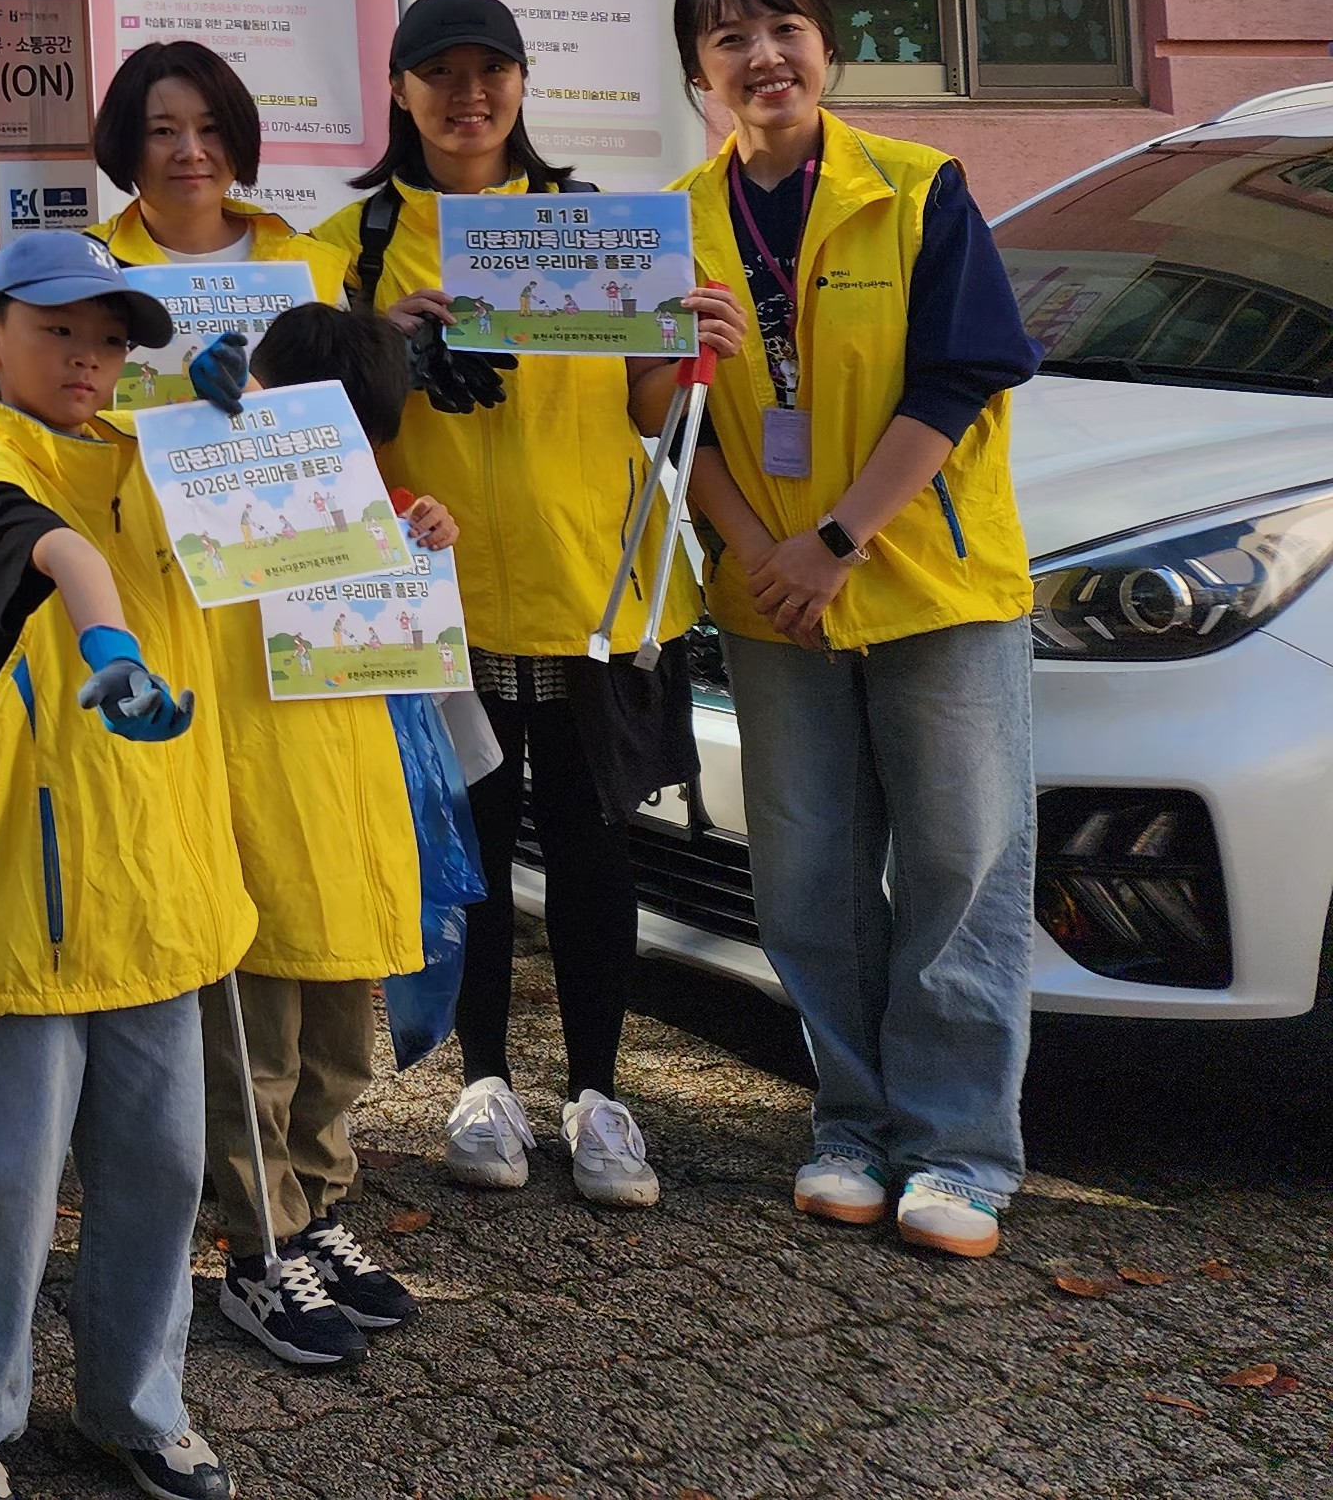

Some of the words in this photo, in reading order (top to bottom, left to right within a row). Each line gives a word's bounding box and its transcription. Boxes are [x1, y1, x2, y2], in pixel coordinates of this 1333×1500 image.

[571, 10, 588, 21] 전문
[590, 11, 608, 22] 상담
[611, 13, 631, 23] 제공
[224, 18, 270, 31] 교육활동비
[272, 20, 290, 32] 지급
[16, 36, 72, 54] 소통공간
[547, 89, 563, 99] 아동
[564, 90, 580, 100] 대상
[582, 90, 617, 101] 미술치료
[620, 91, 640, 102] 지원
[272, 121, 351, 134] 070-4457-6105
[44, 208, 88, 218] unesco
[537, 208, 552, 224] 제
[558, 209, 567, 223] 1
[573, 208, 589, 224] 회
[466, 230, 559, 250] 다문화가족
[563, 229, 660, 249] 나눔봉사단
[470, 255, 530, 269] 2026년
[536, 254, 600, 270] 우리마을
[604, 254, 652, 270] 플로깅
[191, 277, 205, 290] 제
[210, 278, 217, 290] 1
[221, 277, 235, 290] 회
[216, 295, 293, 314] 나눔봉사단
[248, 413, 258, 429] 1
[259, 410, 275, 426] 회
[168, 438, 258, 473] 다문화가족
[257, 425, 342, 459] 나눔봉사단
[181, 473, 240, 498] 2026년
[243, 462, 299, 487] 우리마을
[301, 455, 343, 477] 플로깅
[342, 582, 392, 600] 우리마을
[395, 582, 429, 598] 플로깅
